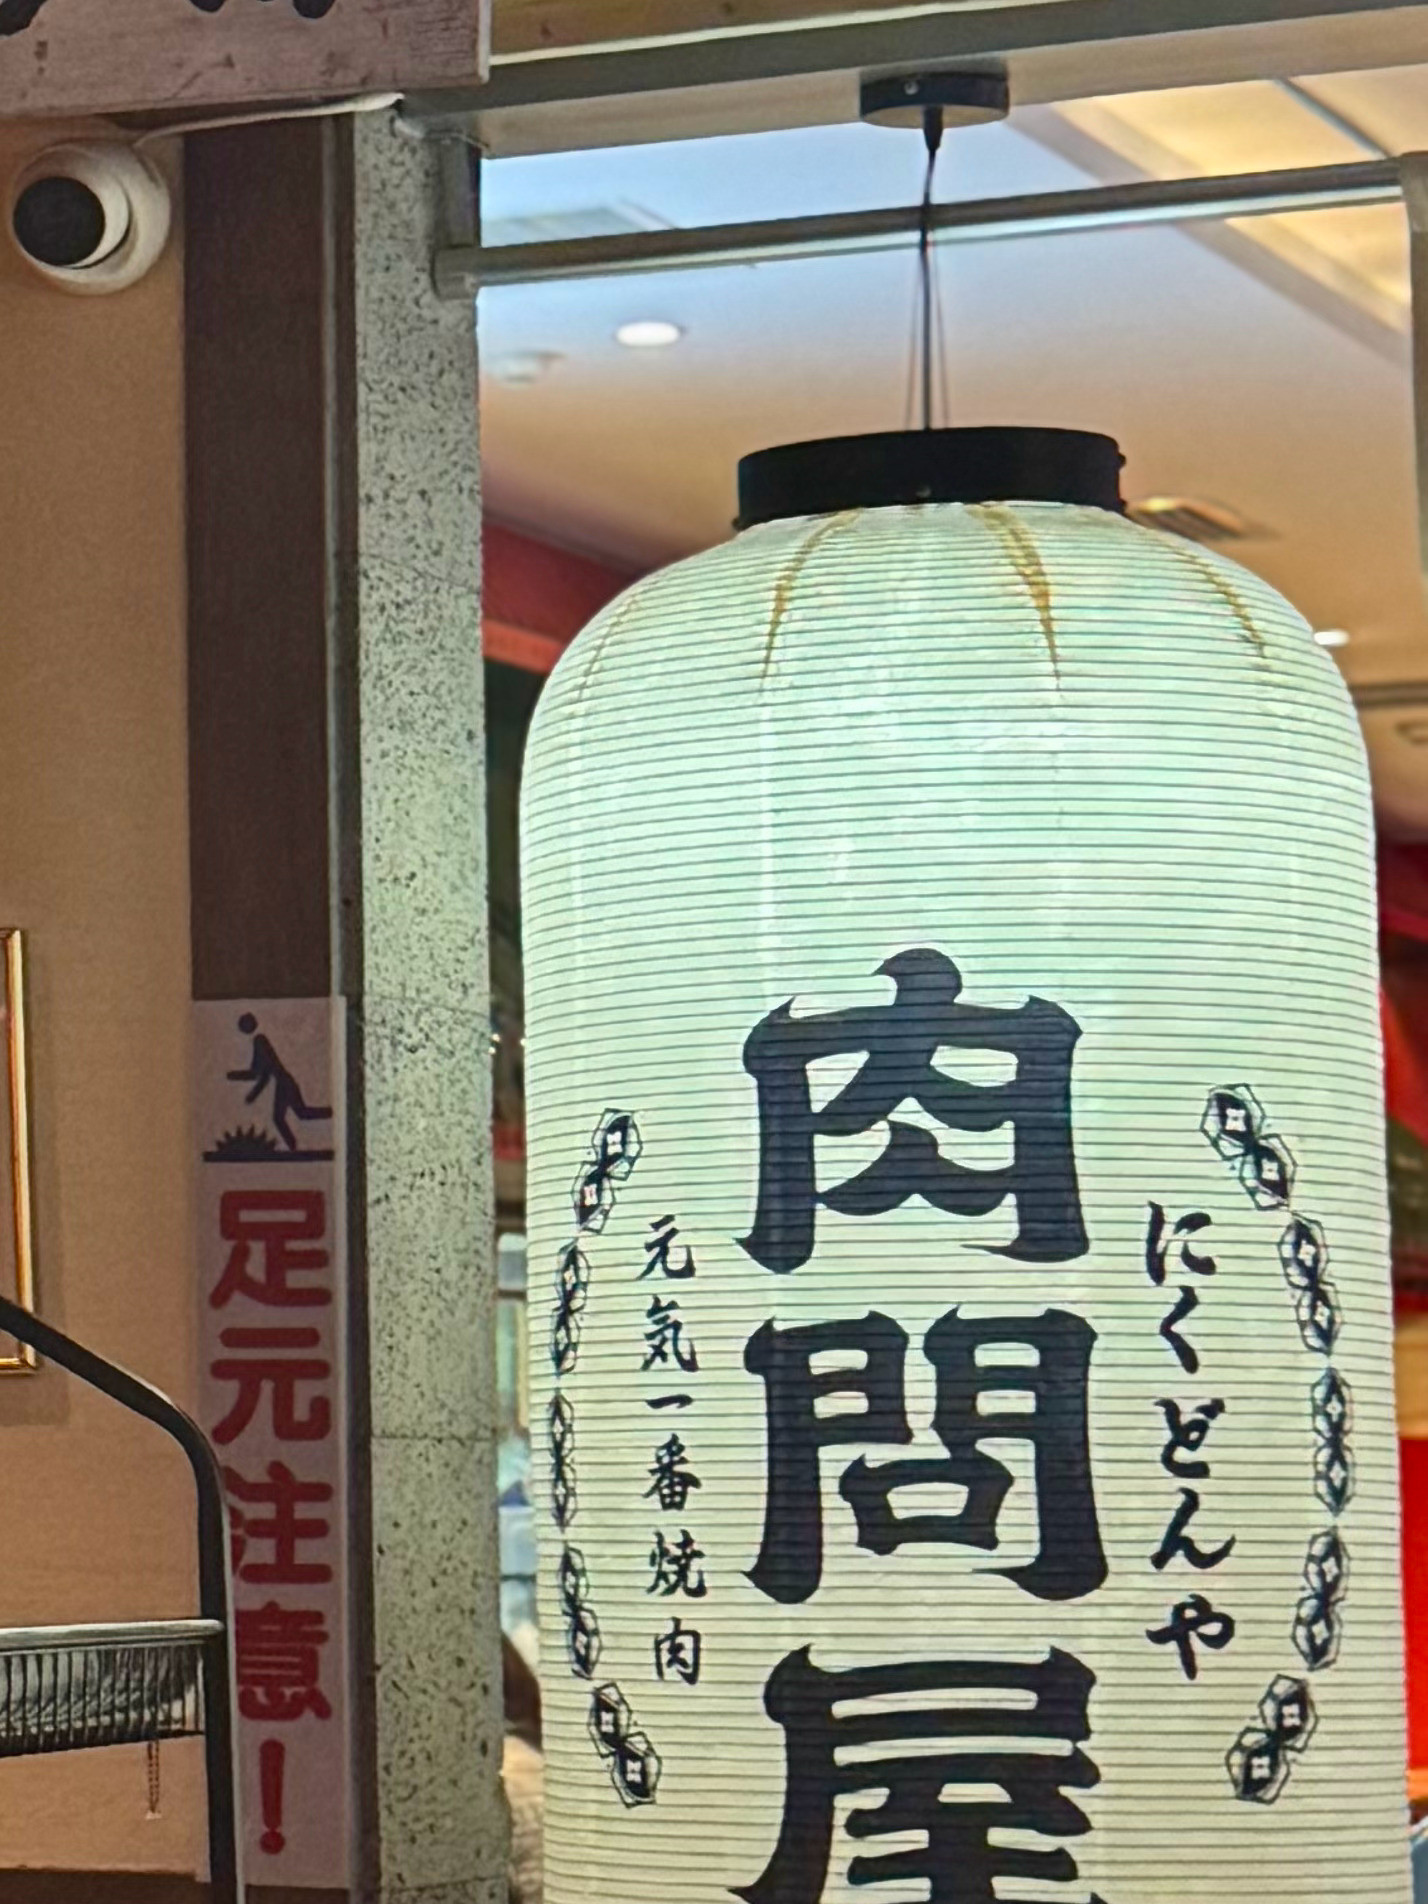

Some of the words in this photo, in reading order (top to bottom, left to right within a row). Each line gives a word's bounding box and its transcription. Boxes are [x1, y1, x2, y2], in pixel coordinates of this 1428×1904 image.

[633, 1213, 709, 1684] 元気一番焼肉
[1144, 1201, 1236, 1679] にくどんや
